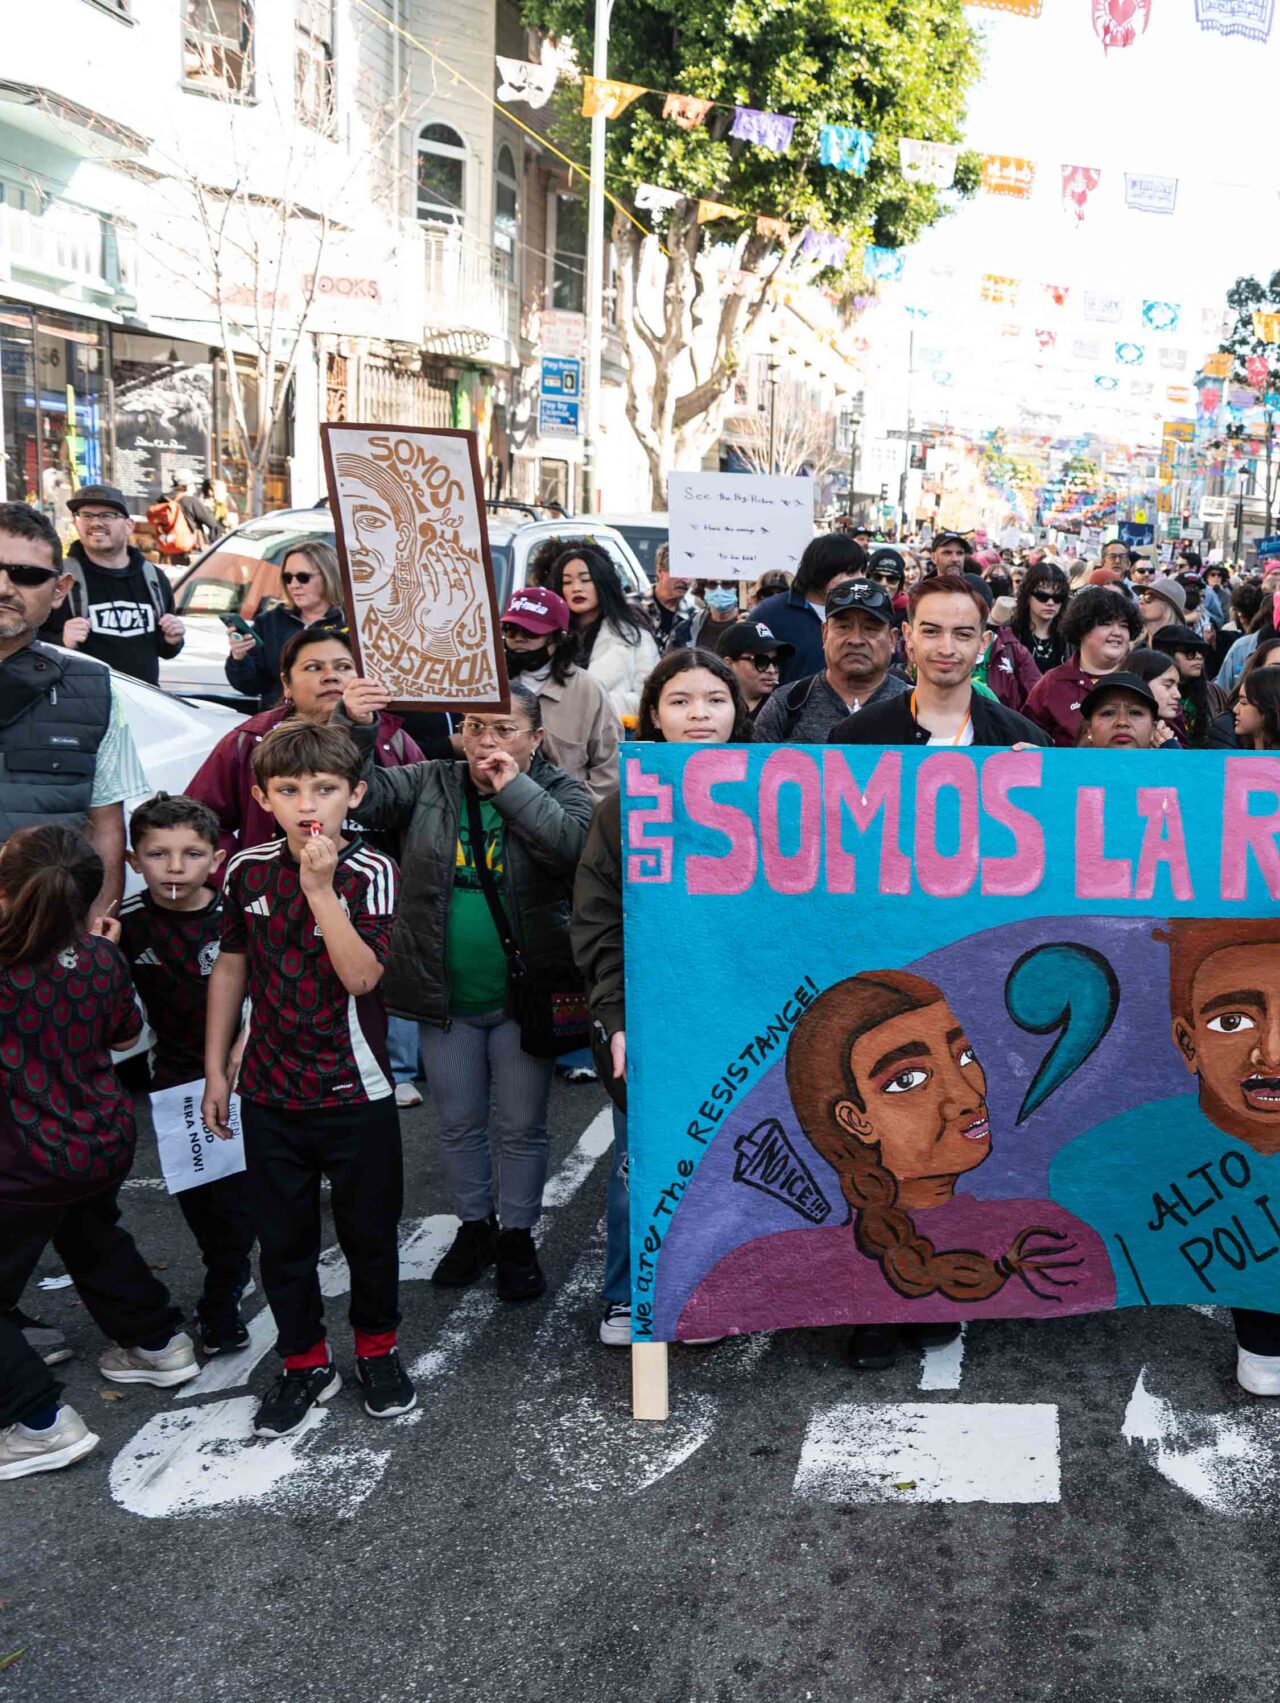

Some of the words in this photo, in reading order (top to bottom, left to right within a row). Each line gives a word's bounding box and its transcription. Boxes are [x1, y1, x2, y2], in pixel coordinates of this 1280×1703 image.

[304, 273, 379, 298] BOOKS
[368, 436, 465, 508] SOMOS
[684, 487, 712, 501] See
[426, 507, 464, 529] la
[101, 609, 146, 629] 100%
[362, 603, 494, 688] RESISTENCIA
[682, 748, 1046, 898] SOMOS
[1075, 786, 1194, 901] LA
[687, 974, 822, 1145] RESISTANCE!
[229, 1103, 241, 1137] BIDEN
[189, 1131, 205, 1173] NOW!
[653, 1158, 695, 1217] The
[1148, 1151, 1251, 1231] ALTO
[637, 1225, 662, 1291] are
[635, 1304, 653, 1339] We
